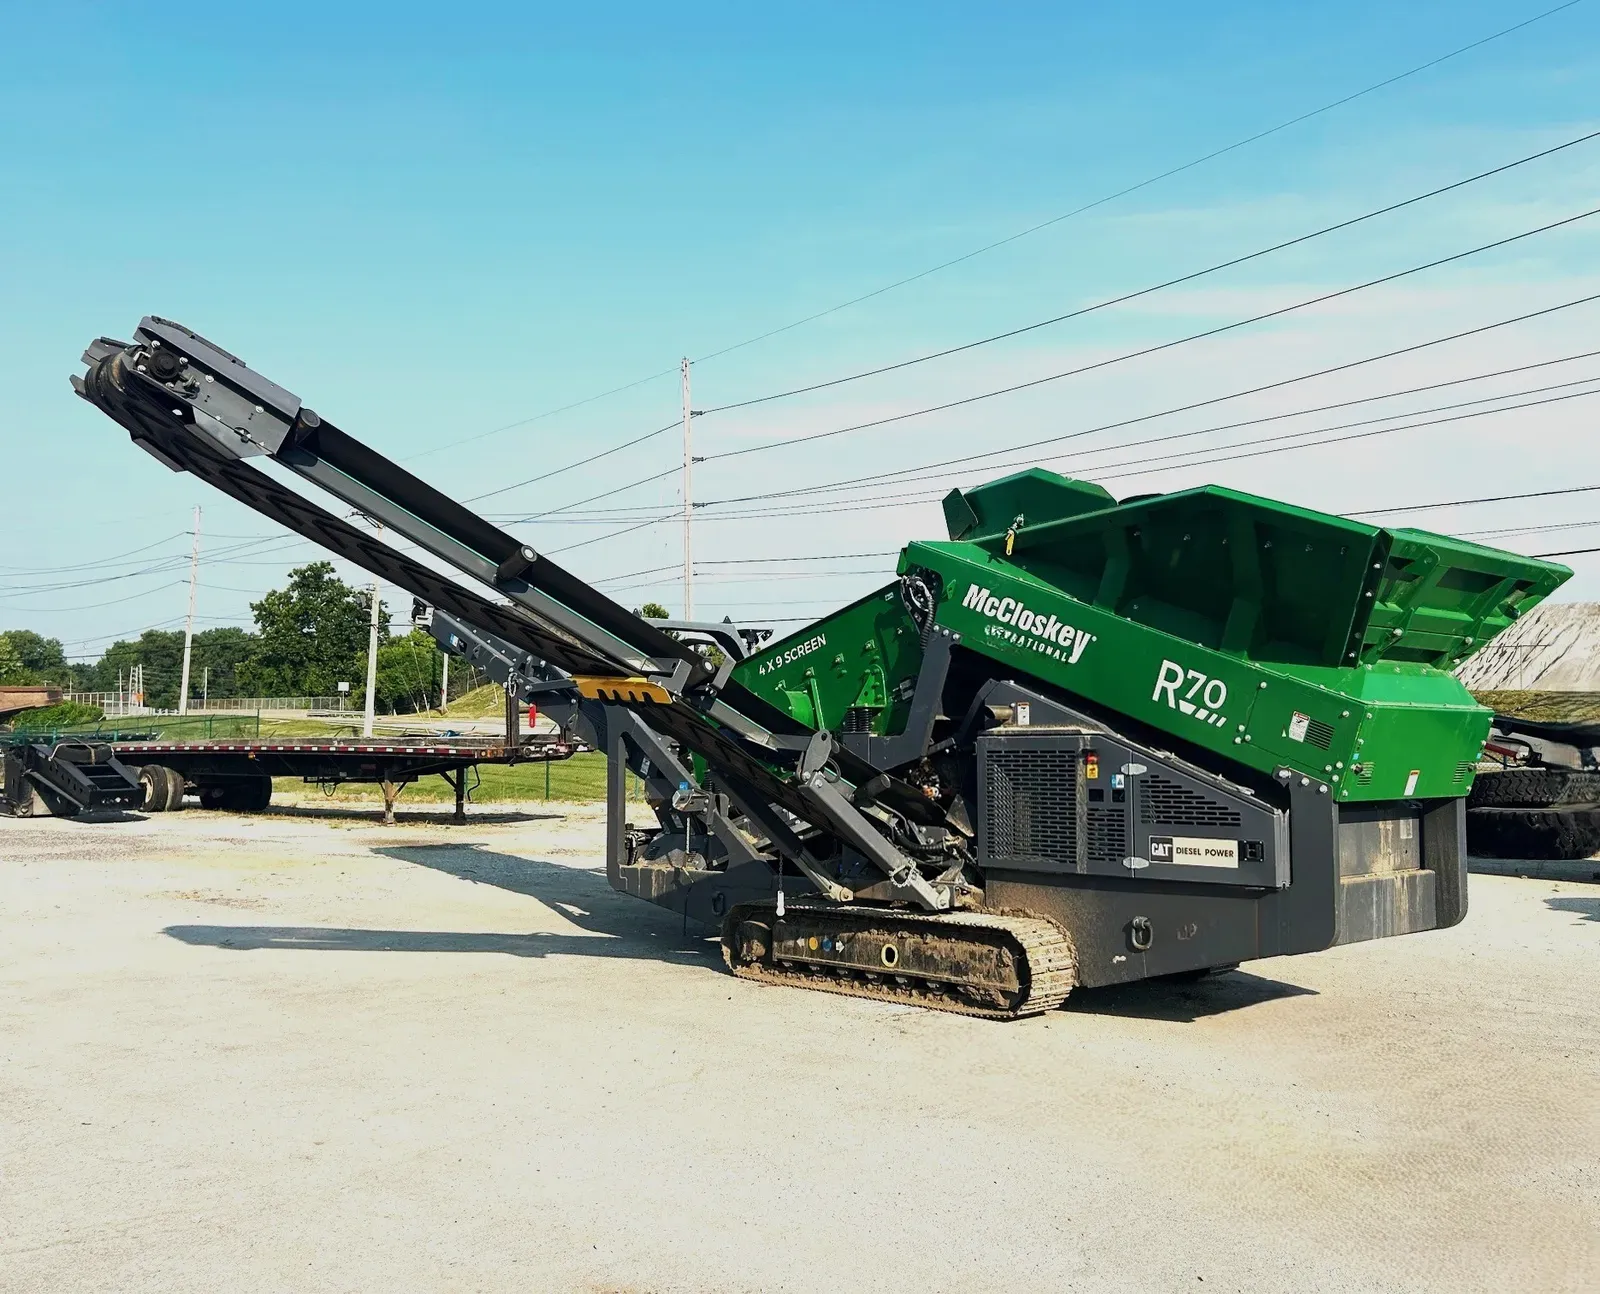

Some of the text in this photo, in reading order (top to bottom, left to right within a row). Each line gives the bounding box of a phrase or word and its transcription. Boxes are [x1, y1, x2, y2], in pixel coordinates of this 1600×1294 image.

[962, 583, 1093, 664] McCloskey
[759, 664, 765, 676] 4
[775, 656, 783, 668] 9
[784, 633, 827, 664] SCREEN
[1151, 659, 1228, 710] R70
[1151, 842, 1235, 858] CAT DIESEL POWER
